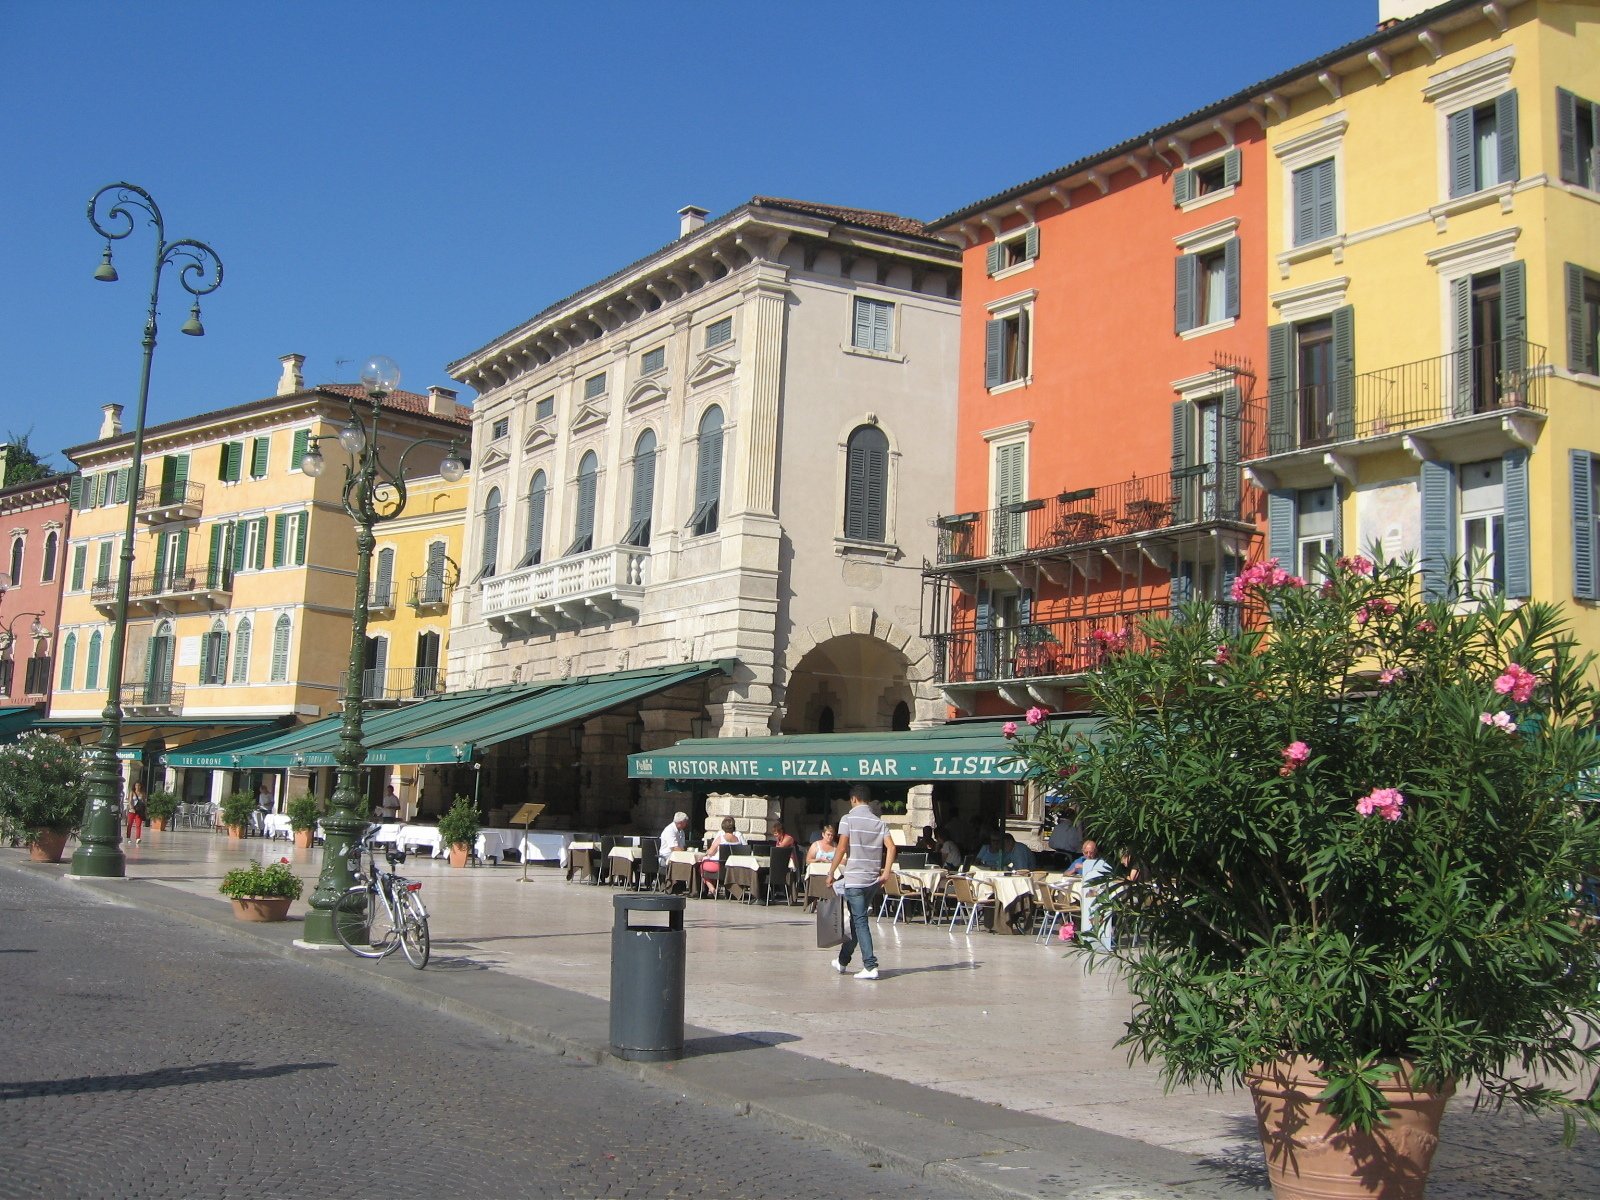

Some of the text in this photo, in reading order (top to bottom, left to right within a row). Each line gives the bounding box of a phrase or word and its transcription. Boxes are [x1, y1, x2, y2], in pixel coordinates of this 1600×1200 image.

[182, 757, 221, 765] TRE CORONE
[668, 760, 759, 776] RISTORANTE
[781, 759, 832, 776] PIZZA
[858, 758, 898, 776] BAR
[932, 756, 1030, 775] LISTON
